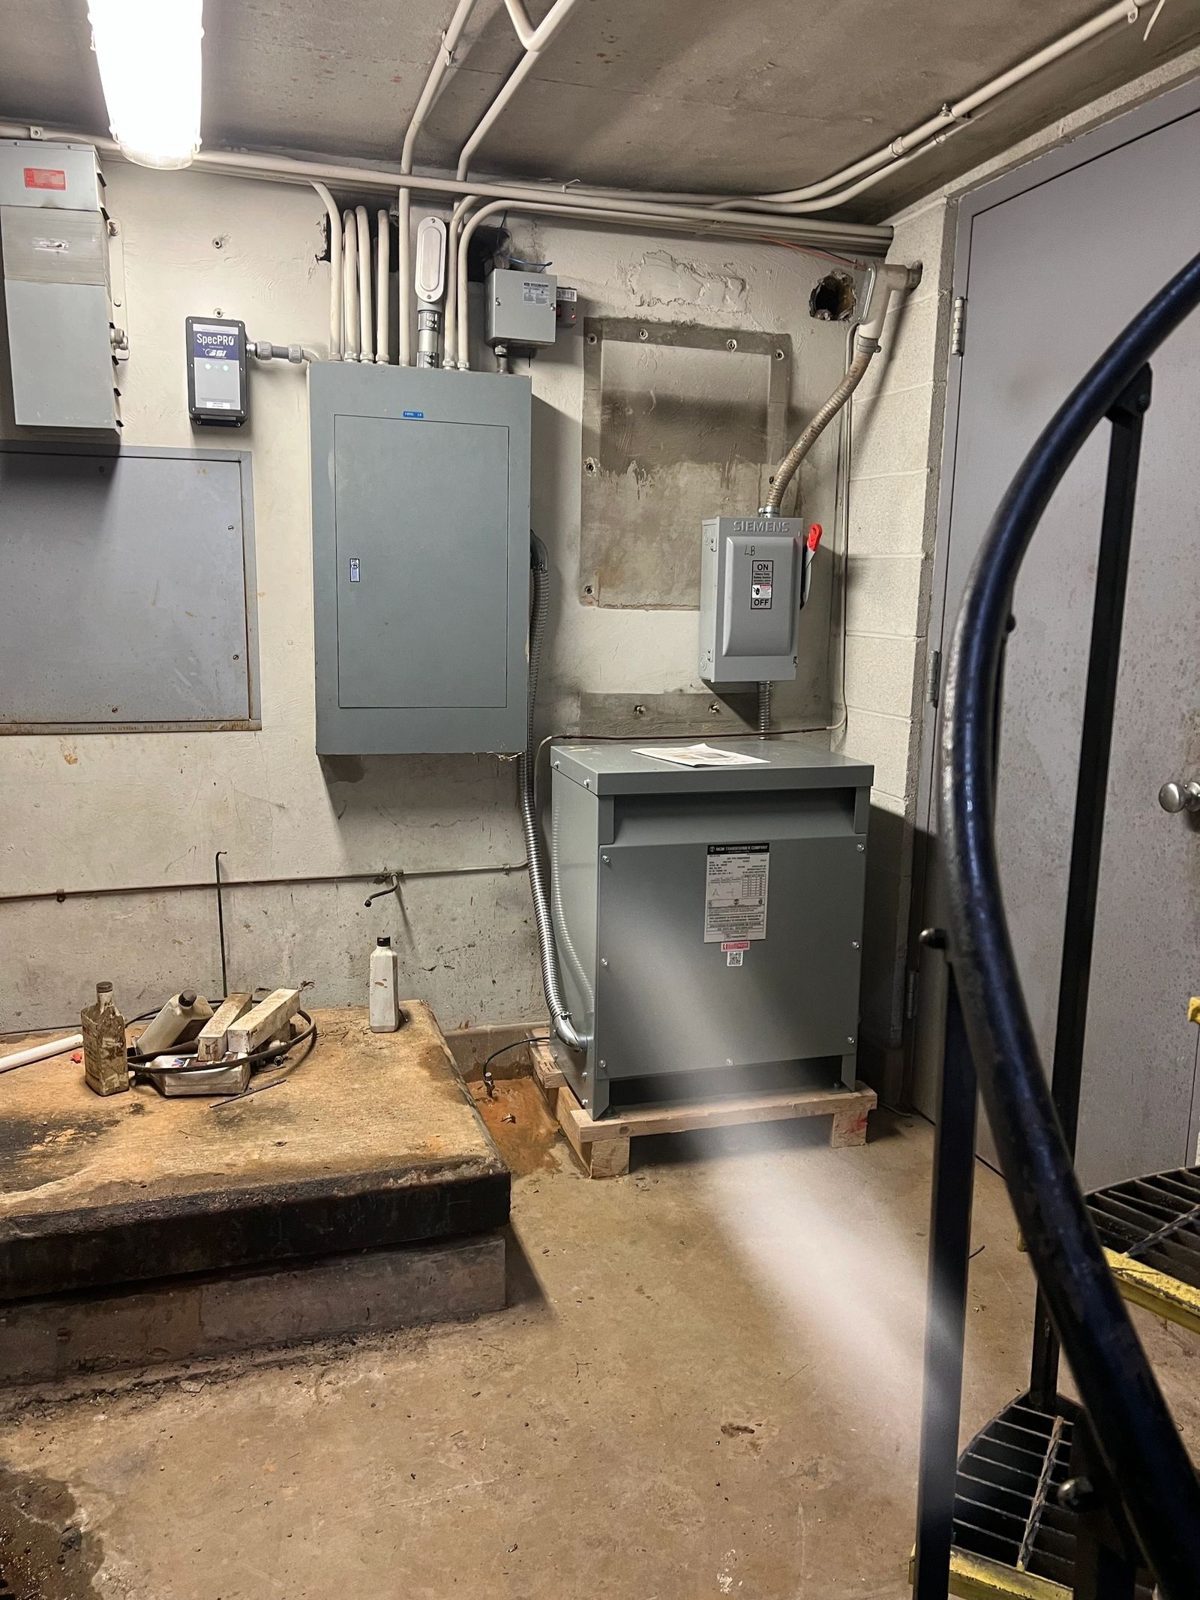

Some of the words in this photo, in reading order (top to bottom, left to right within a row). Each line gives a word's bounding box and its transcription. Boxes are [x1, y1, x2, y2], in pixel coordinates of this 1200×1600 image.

[196, 333, 235, 346] SpecPRO
[733, 520, 790, 533] SIEMENS
[757, 563, 769, 571] ON
